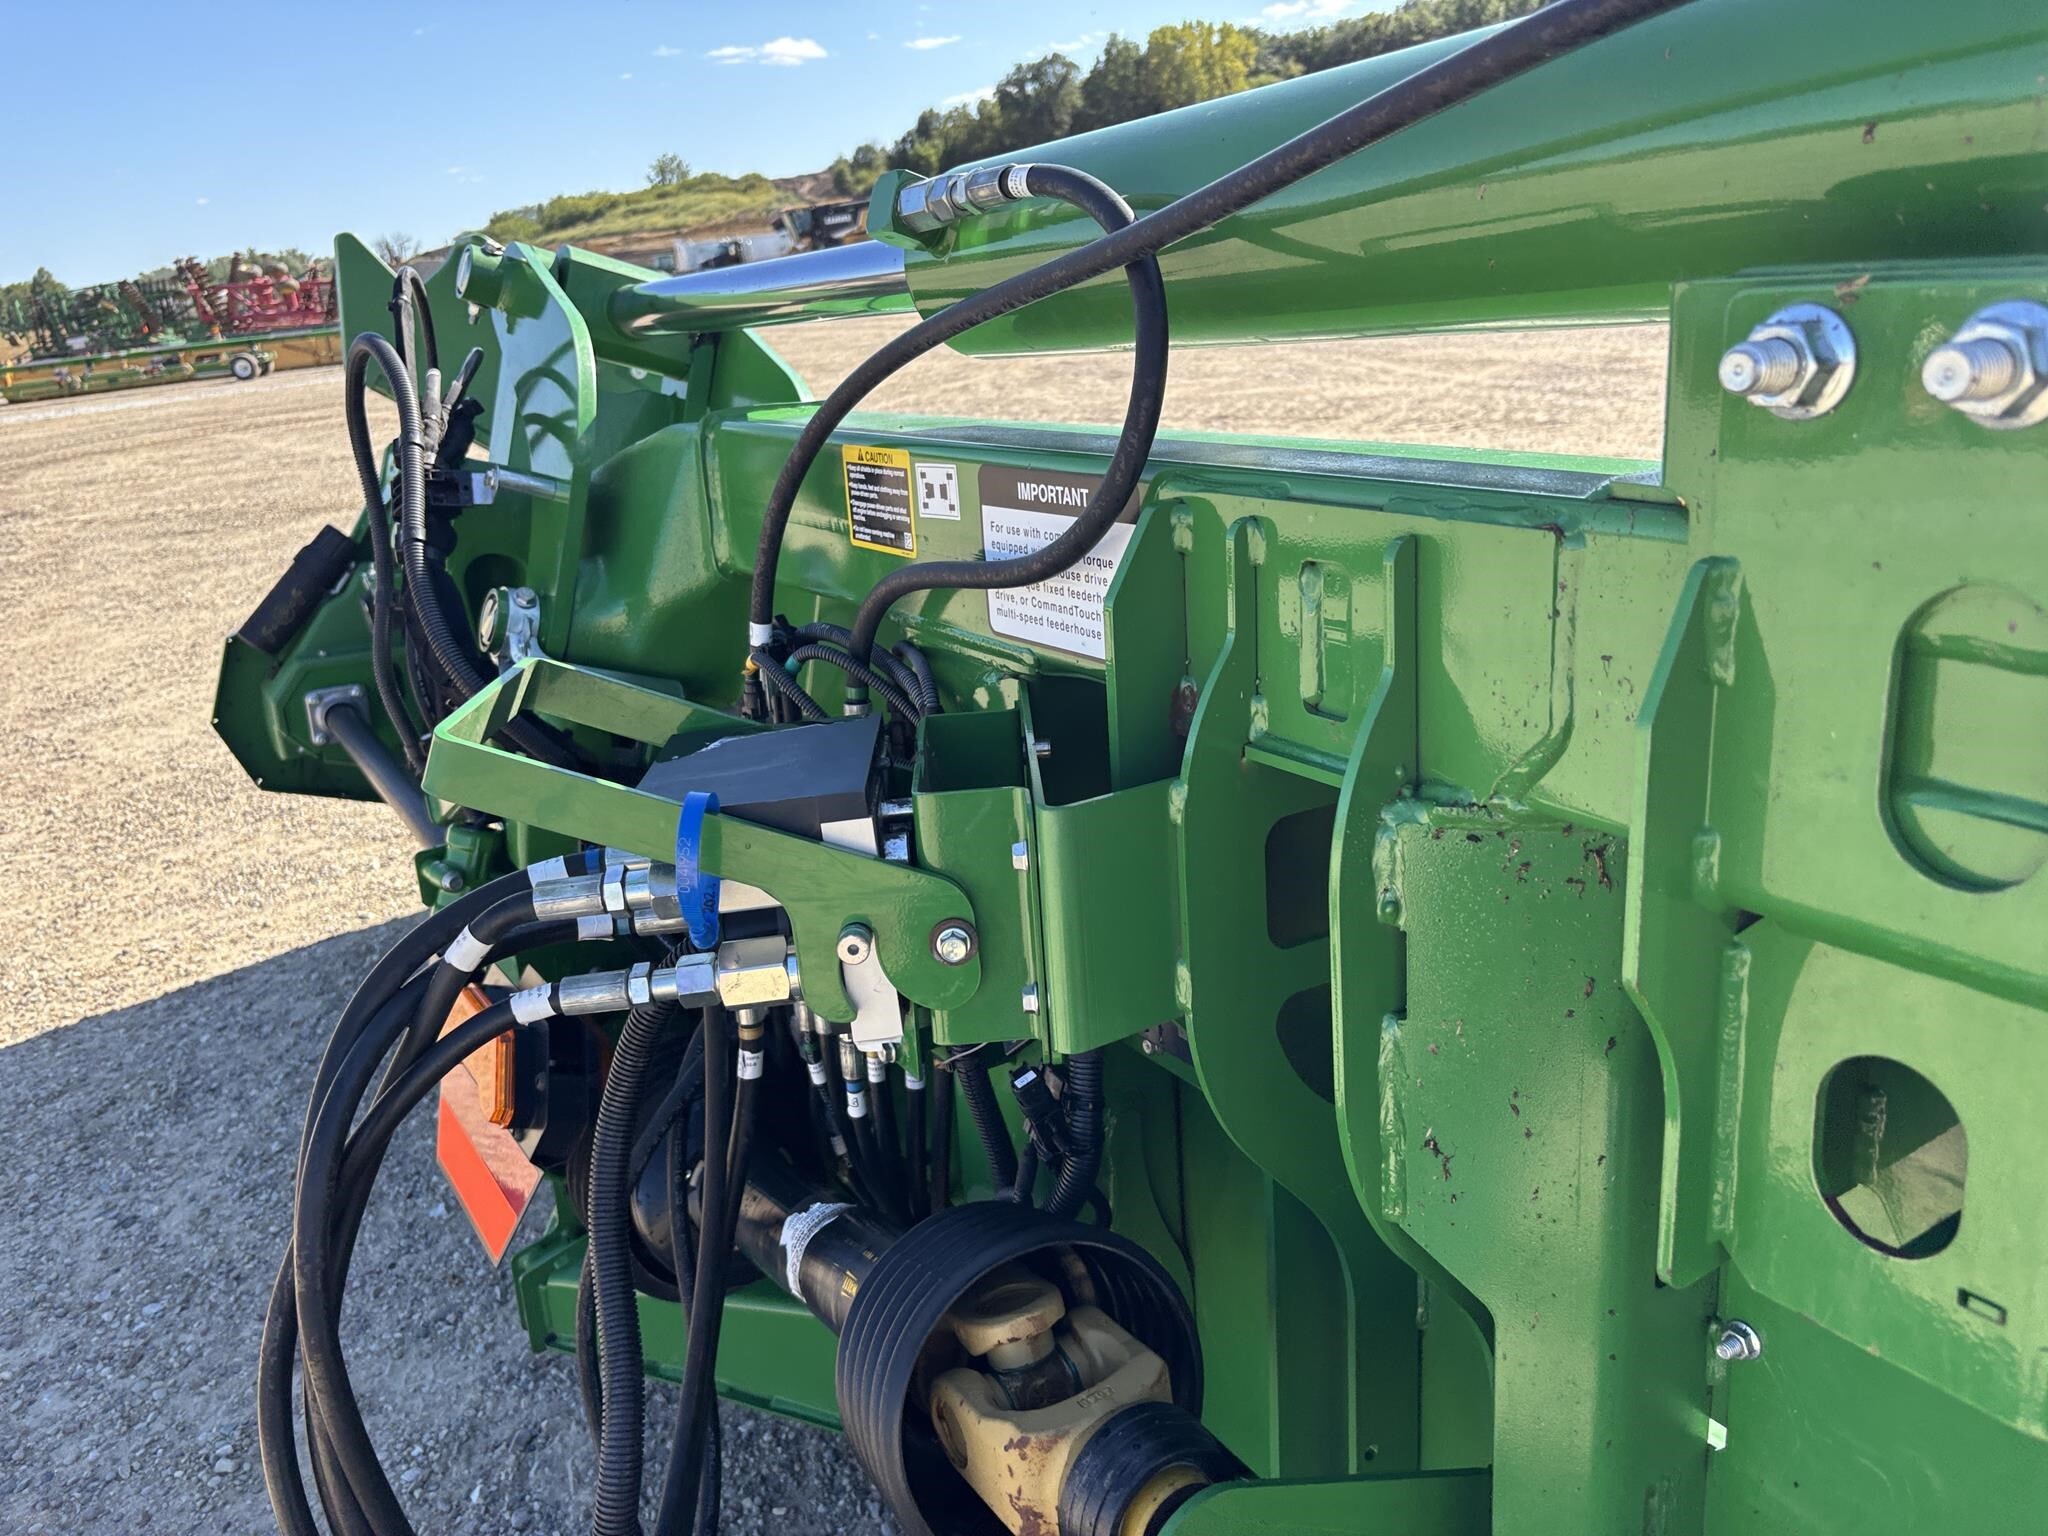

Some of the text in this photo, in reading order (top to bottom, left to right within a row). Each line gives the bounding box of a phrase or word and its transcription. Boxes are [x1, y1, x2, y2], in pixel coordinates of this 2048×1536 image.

[865, 450, 894, 464] CAUTION
[1017, 482, 1089, 507] IMPORTANT
[990, 520, 1066, 541] For use with com
[991, 539, 1029, 556] equipped
[1057, 569, 1108, 587] ouse drive
[995, 589, 1018, 605] drive,
[1020, 596, 1028, 606] or
[1043, 581, 1065, 597] fixed
[996, 606, 1101, 640] multi-speed feederhouse
